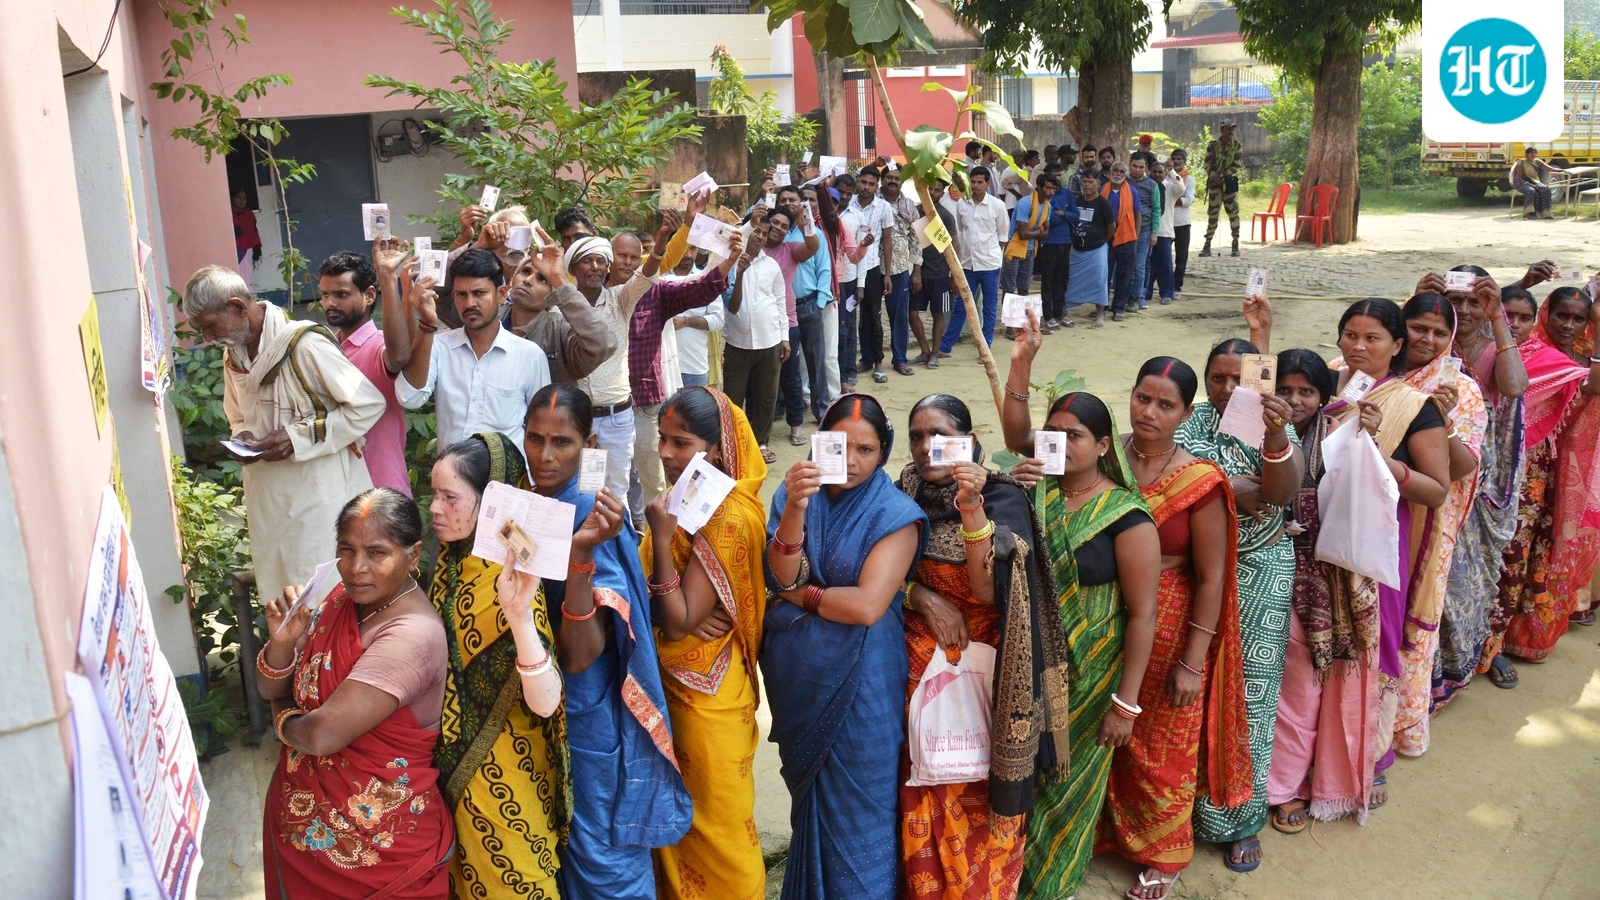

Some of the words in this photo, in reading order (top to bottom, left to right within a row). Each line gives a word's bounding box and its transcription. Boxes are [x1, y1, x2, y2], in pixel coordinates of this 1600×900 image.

[925, 728, 946, 752] Shree
[947, 730, 963, 752] Ram
[965, 726, 989, 750] Fabrics
